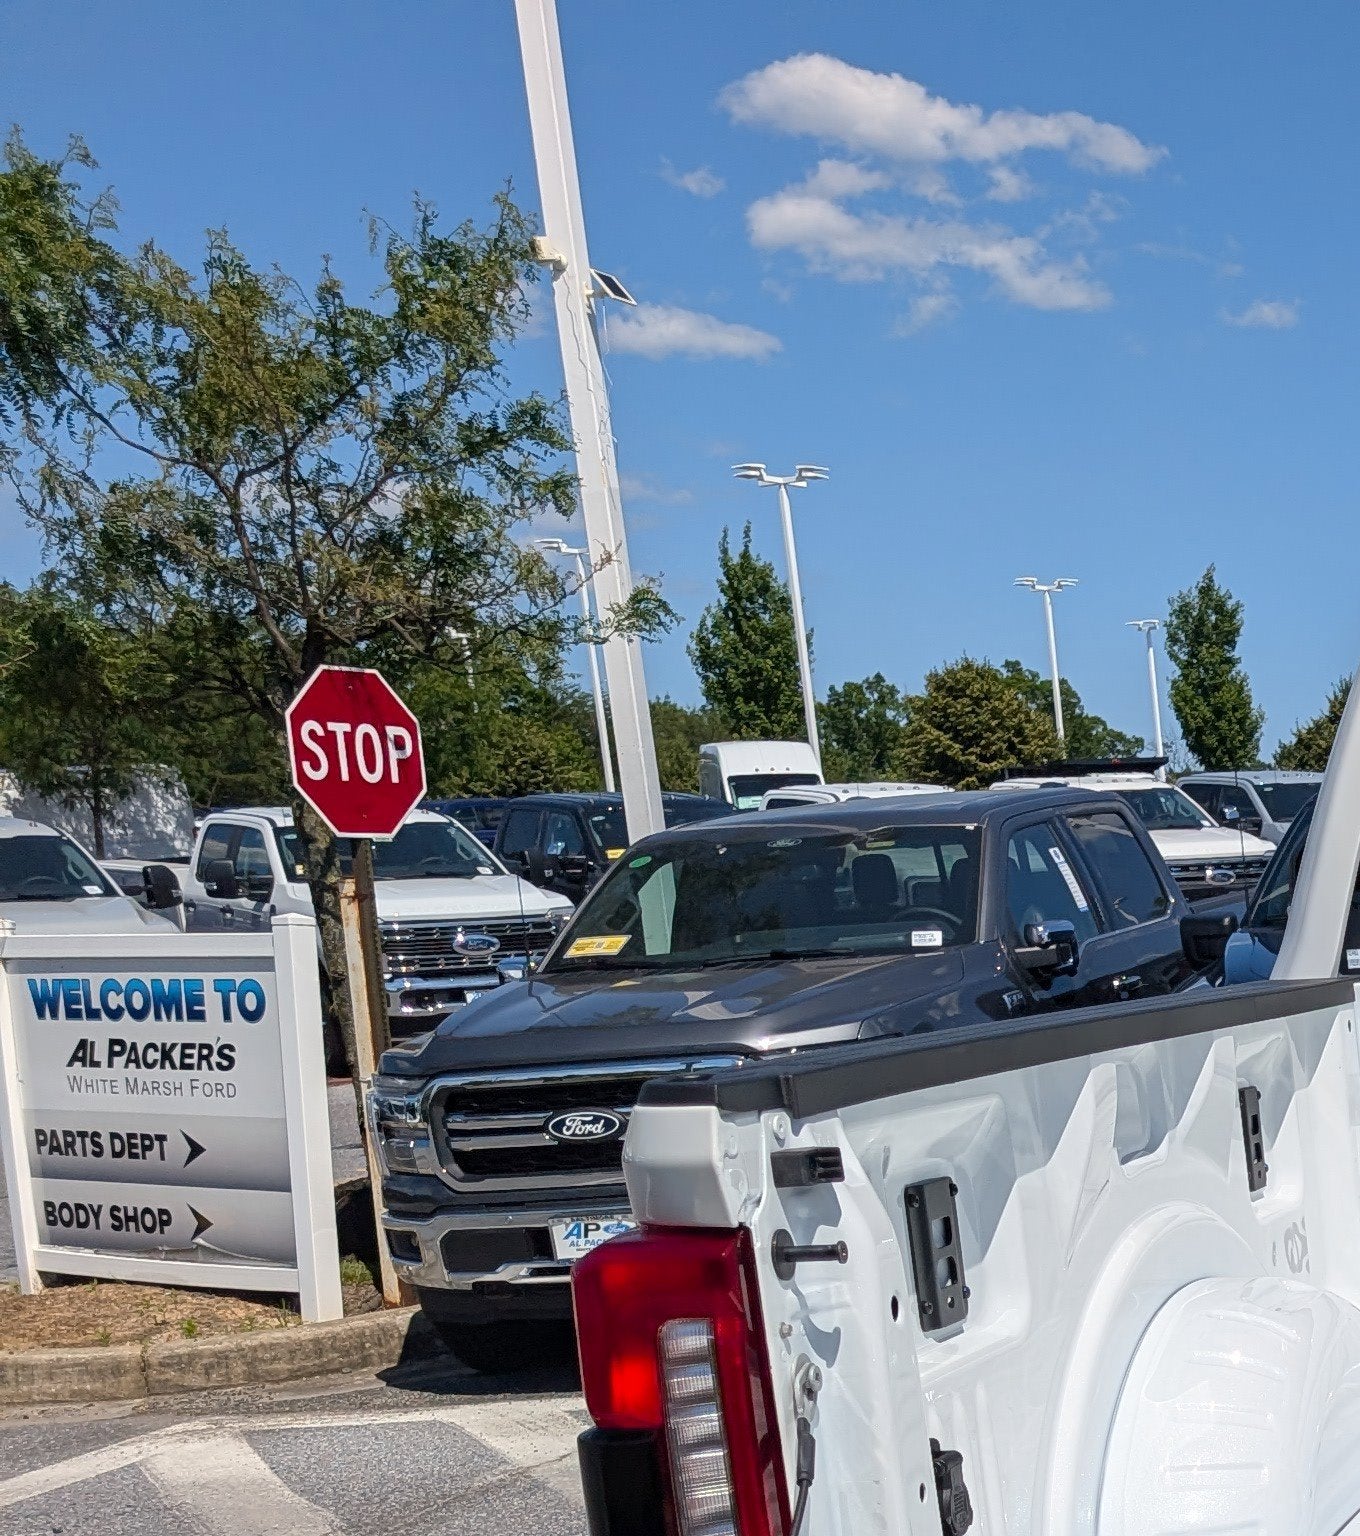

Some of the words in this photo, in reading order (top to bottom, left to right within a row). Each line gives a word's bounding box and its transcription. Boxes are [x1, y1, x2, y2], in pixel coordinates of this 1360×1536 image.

[300, 719, 413, 784] STOP
[27, 977, 208, 1023] WELCOME
[213, 978, 267, 1024] TO
[66, 1038, 101, 1069] AL
[107, 1036, 237, 1071] PACKER'S
[67, 1074, 119, 1095] WHITE
[125, 1076, 184, 1097] MARSH
[190, 1078, 237, 1099] FORD
[562, 1115, 606, 1136] Ford
[34, 1128, 104, 1158] PARTS
[109, 1131, 168, 1161] DEPT
[43, 1201, 103, 1230] BODY
[109, 1204, 173, 1234] SHOP
[563, 1222, 601, 1240] AP
[568, 1239, 581, 1248] AL
